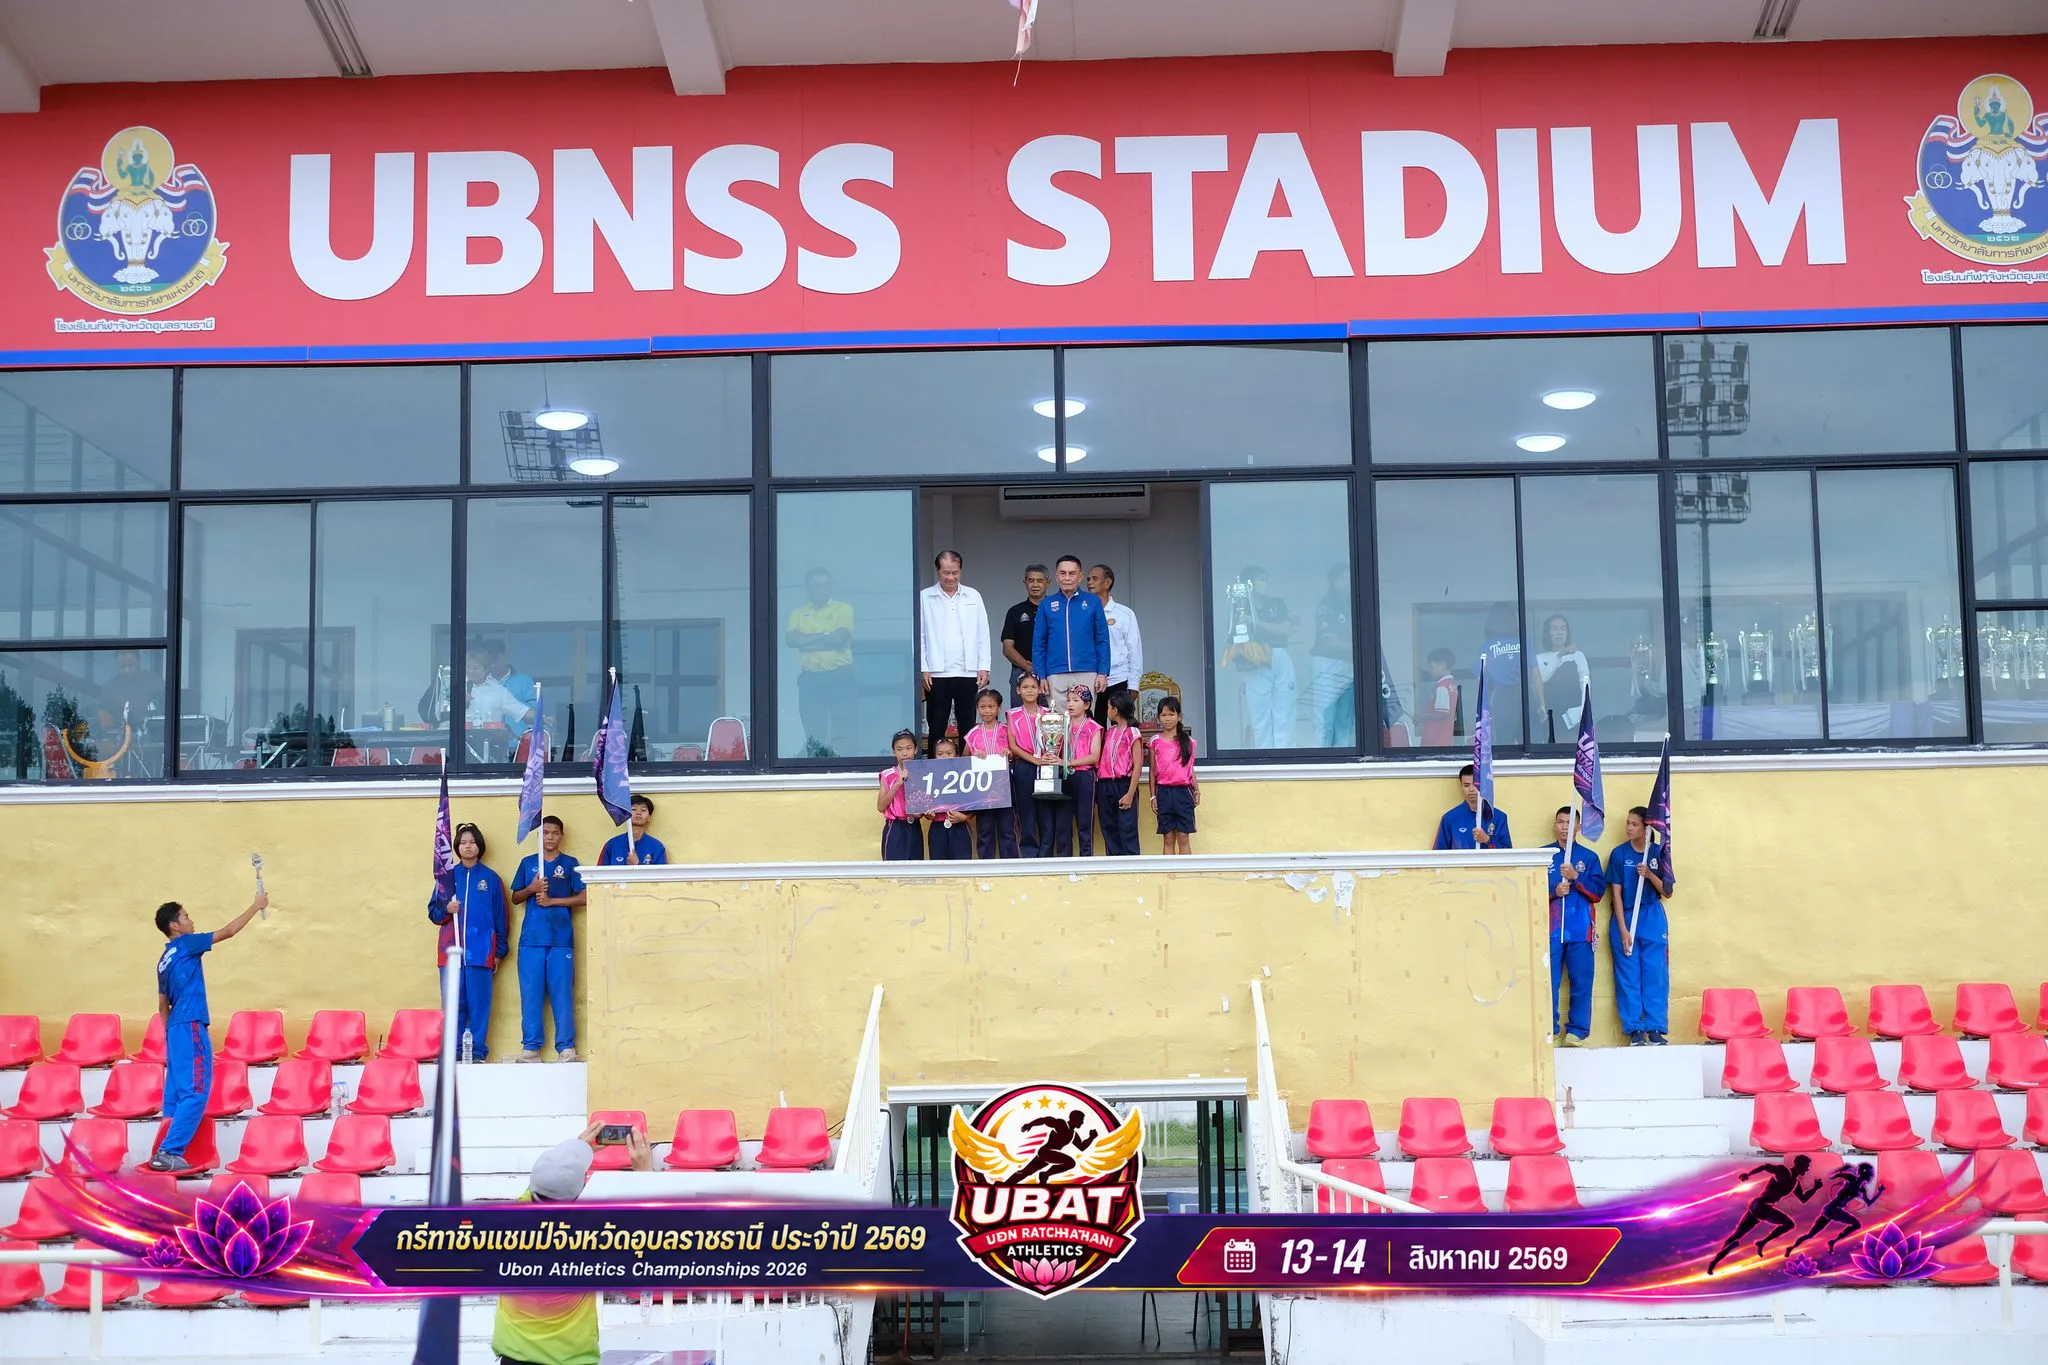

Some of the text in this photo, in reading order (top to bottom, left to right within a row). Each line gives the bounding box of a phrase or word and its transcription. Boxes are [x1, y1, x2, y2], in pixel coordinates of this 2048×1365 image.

[289, 118, 1848, 300] UBNSS STADIUM
[67, 270, 205, 308] มหาวิทยาลัยการกีฬาแห่งชาติ
[56, 319, 213, 333] โรงเรียนกีฬาจังหวัดอุบลราชธานี
[1490, 641, 1520, 658] Thailan
[922, 769, 993, 798] 1,200
